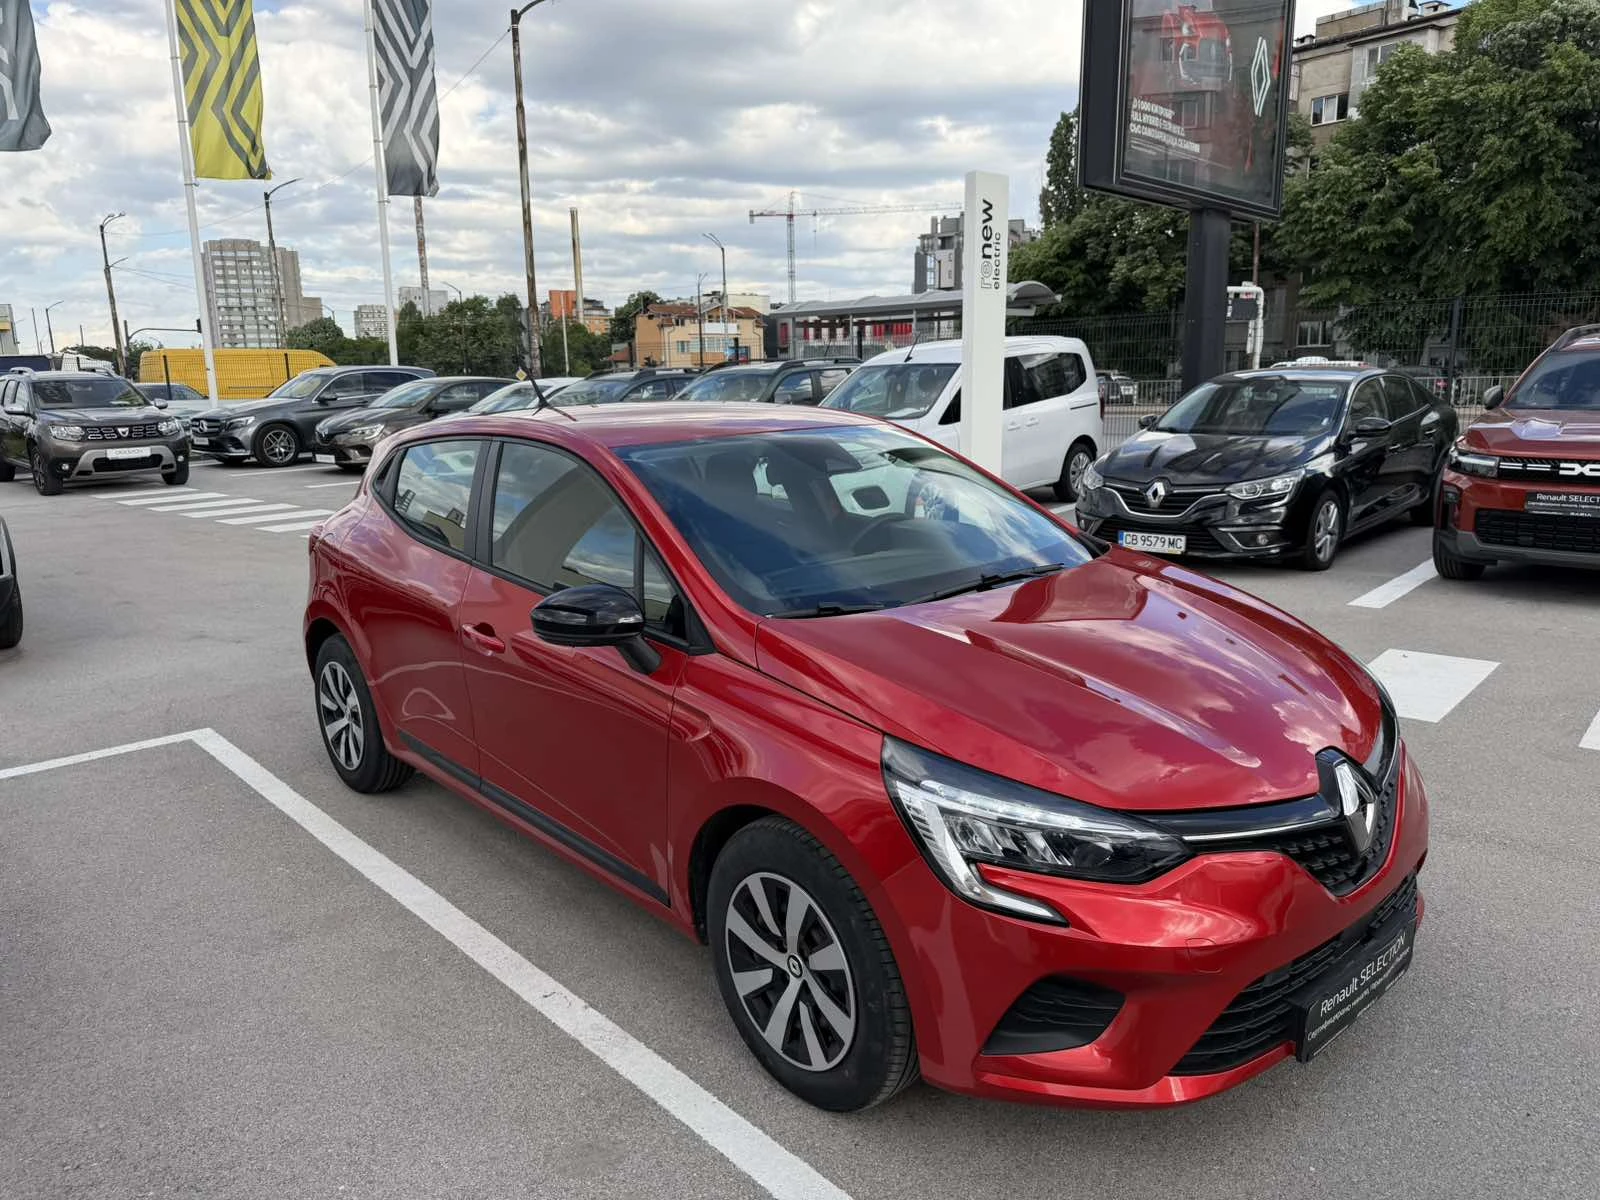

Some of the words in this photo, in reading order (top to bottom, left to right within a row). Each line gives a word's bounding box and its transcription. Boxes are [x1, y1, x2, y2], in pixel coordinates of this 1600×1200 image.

[981, 198, 993, 289] renew
[992, 232, 1001, 290] electric
[1536, 493, 1567, 502] Renault
[1124, 533, 1138, 546] CB
[1140, 535, 1166, 548] 9579
[1168, 537, 1183, 550] MC
[1320, 977, 1359, 1017] Renault
[1360, 931, 1406, 986] SELECTION
